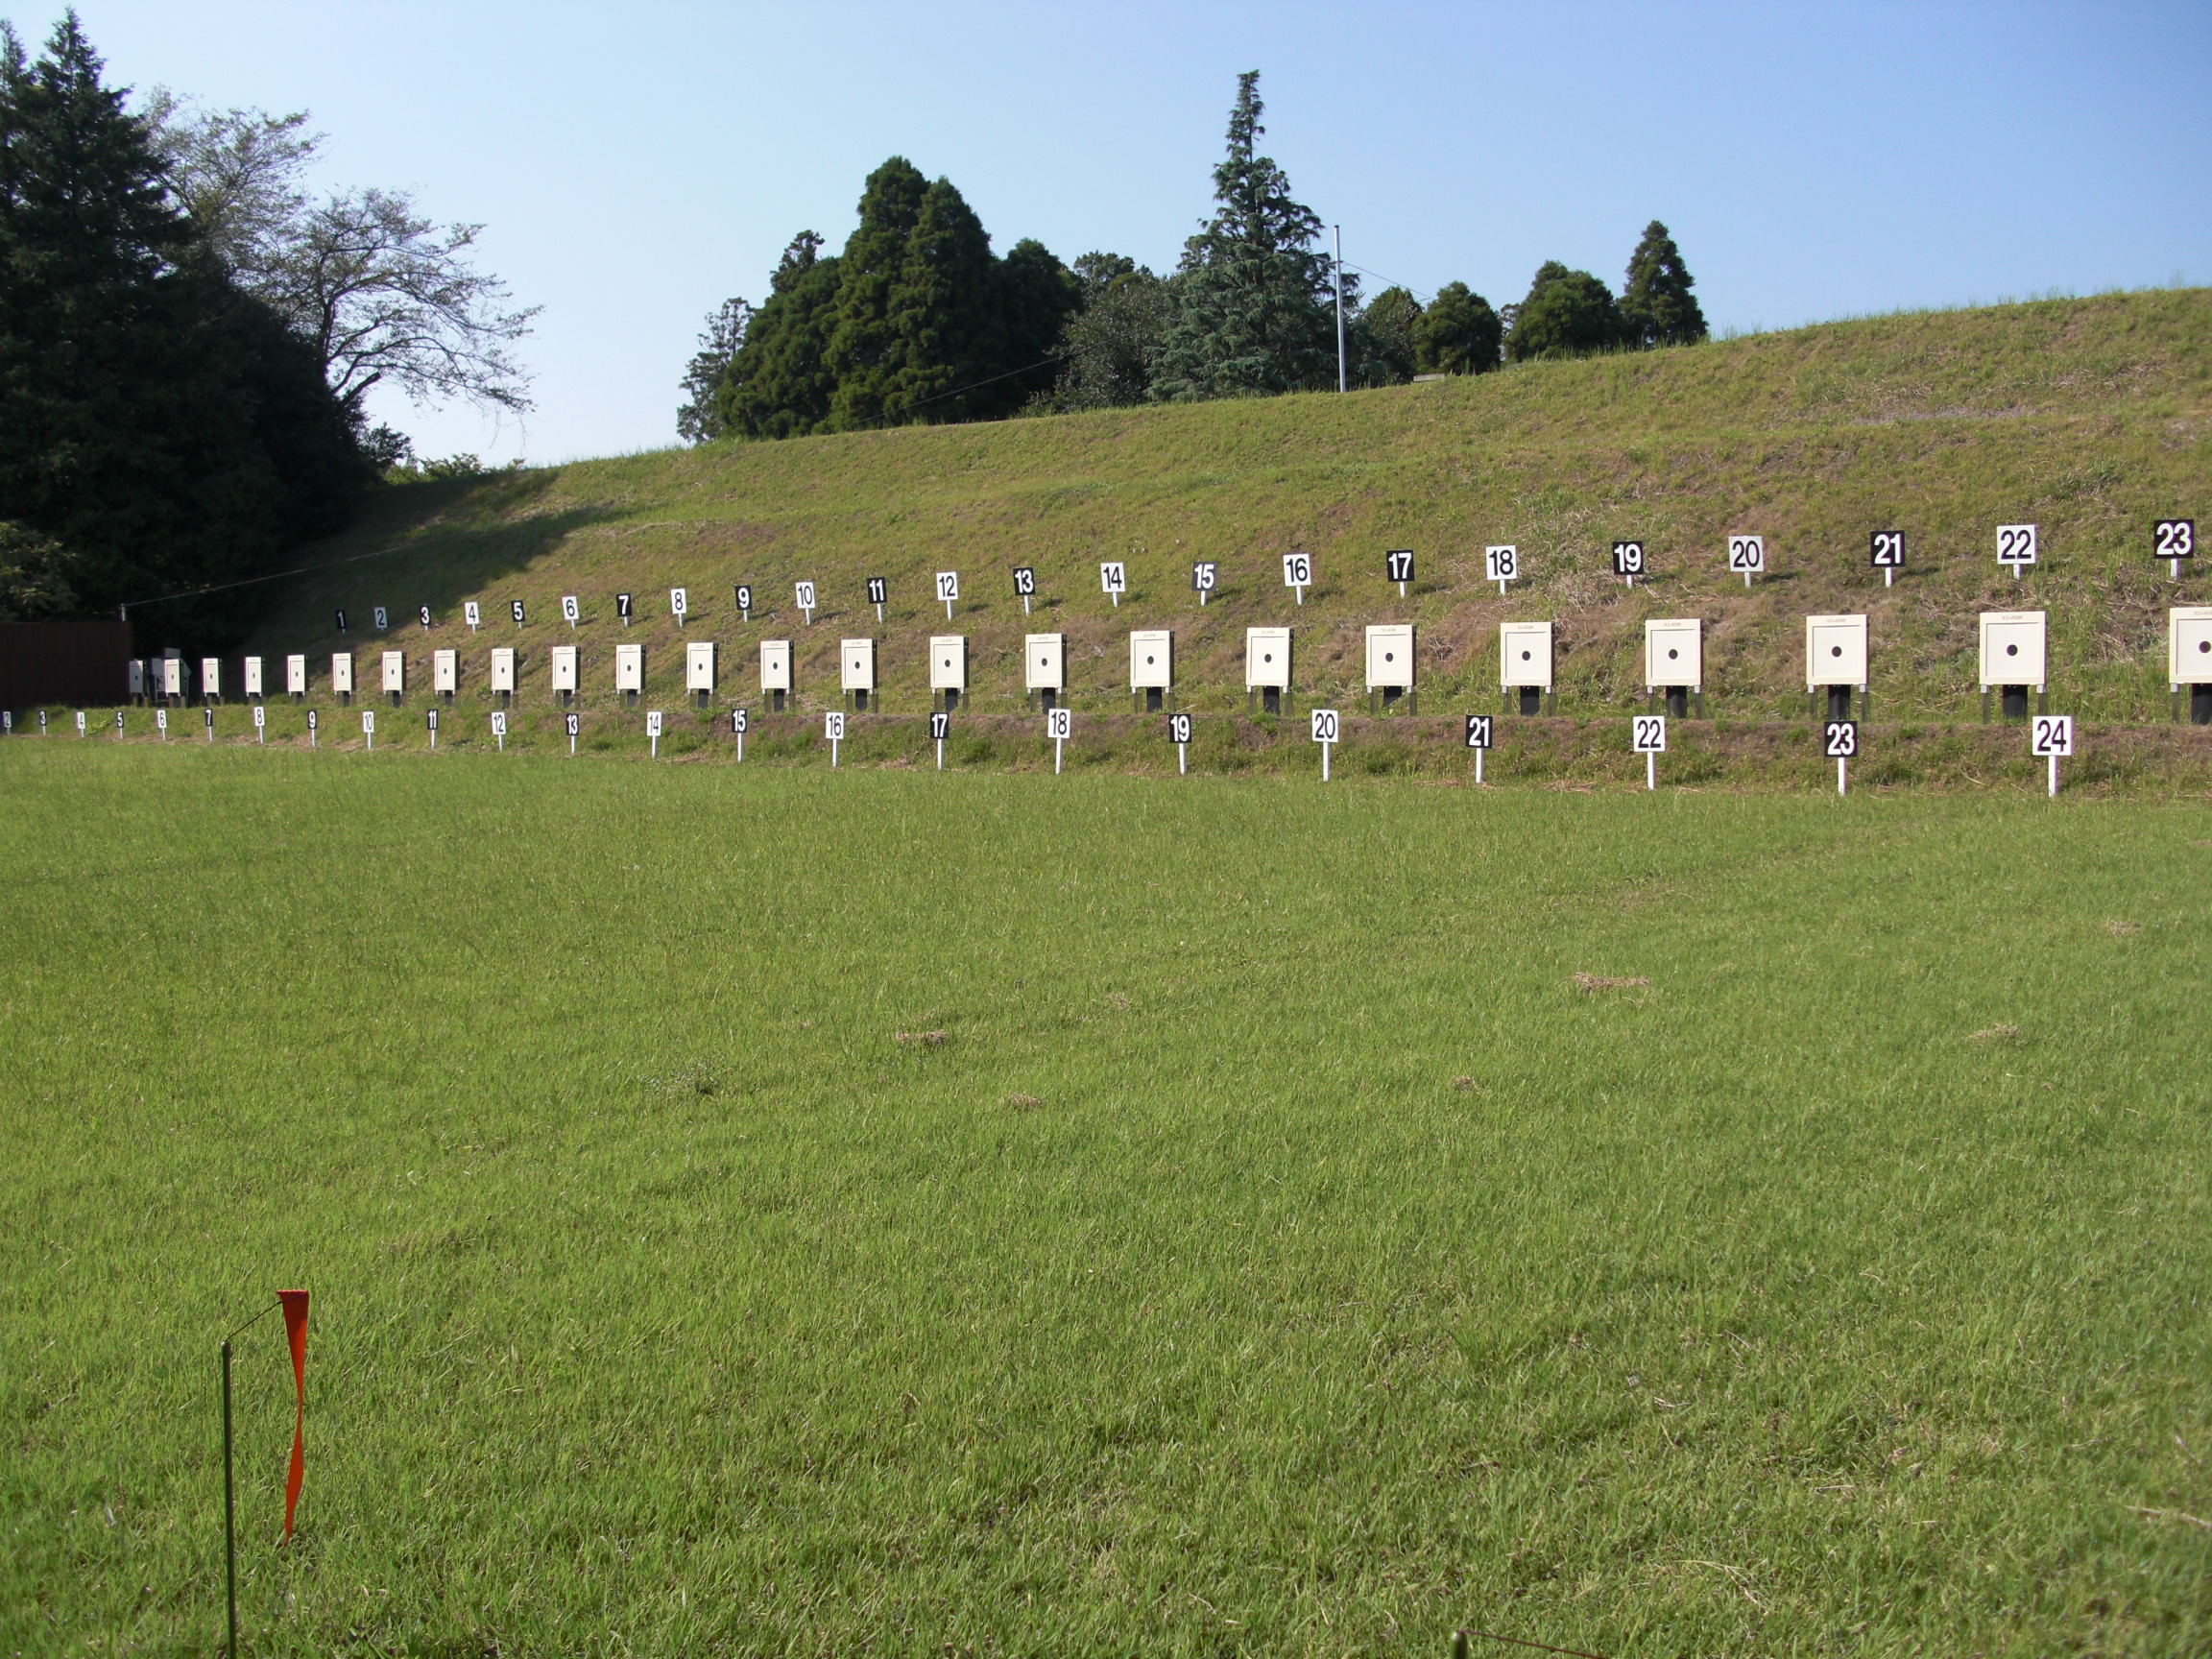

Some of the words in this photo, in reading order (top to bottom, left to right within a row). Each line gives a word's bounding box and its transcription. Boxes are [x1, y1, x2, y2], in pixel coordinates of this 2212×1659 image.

[2000, 530, 2032, 560] 22
[2157, 522, 2191, 555] 23
[1614, 544, 1641, 572] 19
[1732, 540, 1759, 568] 20
[1874, 533, 1901, 565] 21
[1286, 558, 1308, 582] 16
[1389, 553, 1412, 579] 17
[1489, 549, 1513, 575] 18
[939, 576, 954, 596] 12
[1015, 571, 1033, 593] 13
[1104, 566, 1121, 589] 14
[1194, 565, 1214, 589] 15
[738, 588, 749, 608] 9
[798, 586, 812, 605] 10
[869, 581, 884, 601] 11
[514, 603, 522, 619] 5
[566, 599, 575, 616] 6
[618, 595, 629, 615] 7
[675, 592, 683, 611] 8
[338, 611, 344, 628] 1
[377, 610, 385, 626] 2
[421, 607, 429, 624] 3
[469, 605, 476, 621] 4
[117, 712, 123, 727] 5
[158, 711, 165, 726] 6
[205, 710, 213, 726] 7
[255, 709, 263, 724] 8
[308, 711, 315, 728] 9
[365, 713, 373, 730] 10
[428, 710, 437, 729] 11
[493, 714, 504, 733] 12
[566, 715, 578, 734] 13
[649, 714, 659, 733] 14
[733, 711, 746, 732] 15
[829, 715, 842, 736] 16
[931, 714, 947, 737] 17
[1051, 712, 1067, 734] 18
[1315, 713, 1335, 739] 20
[1170, 715, 1190, 741] 19
[1469, 718, 1490, 746] 21
[1638, 720, 1661, 748] 22
[2037, 720, 2067, 752] 24
[1827, 724, 1854, 755] 23
